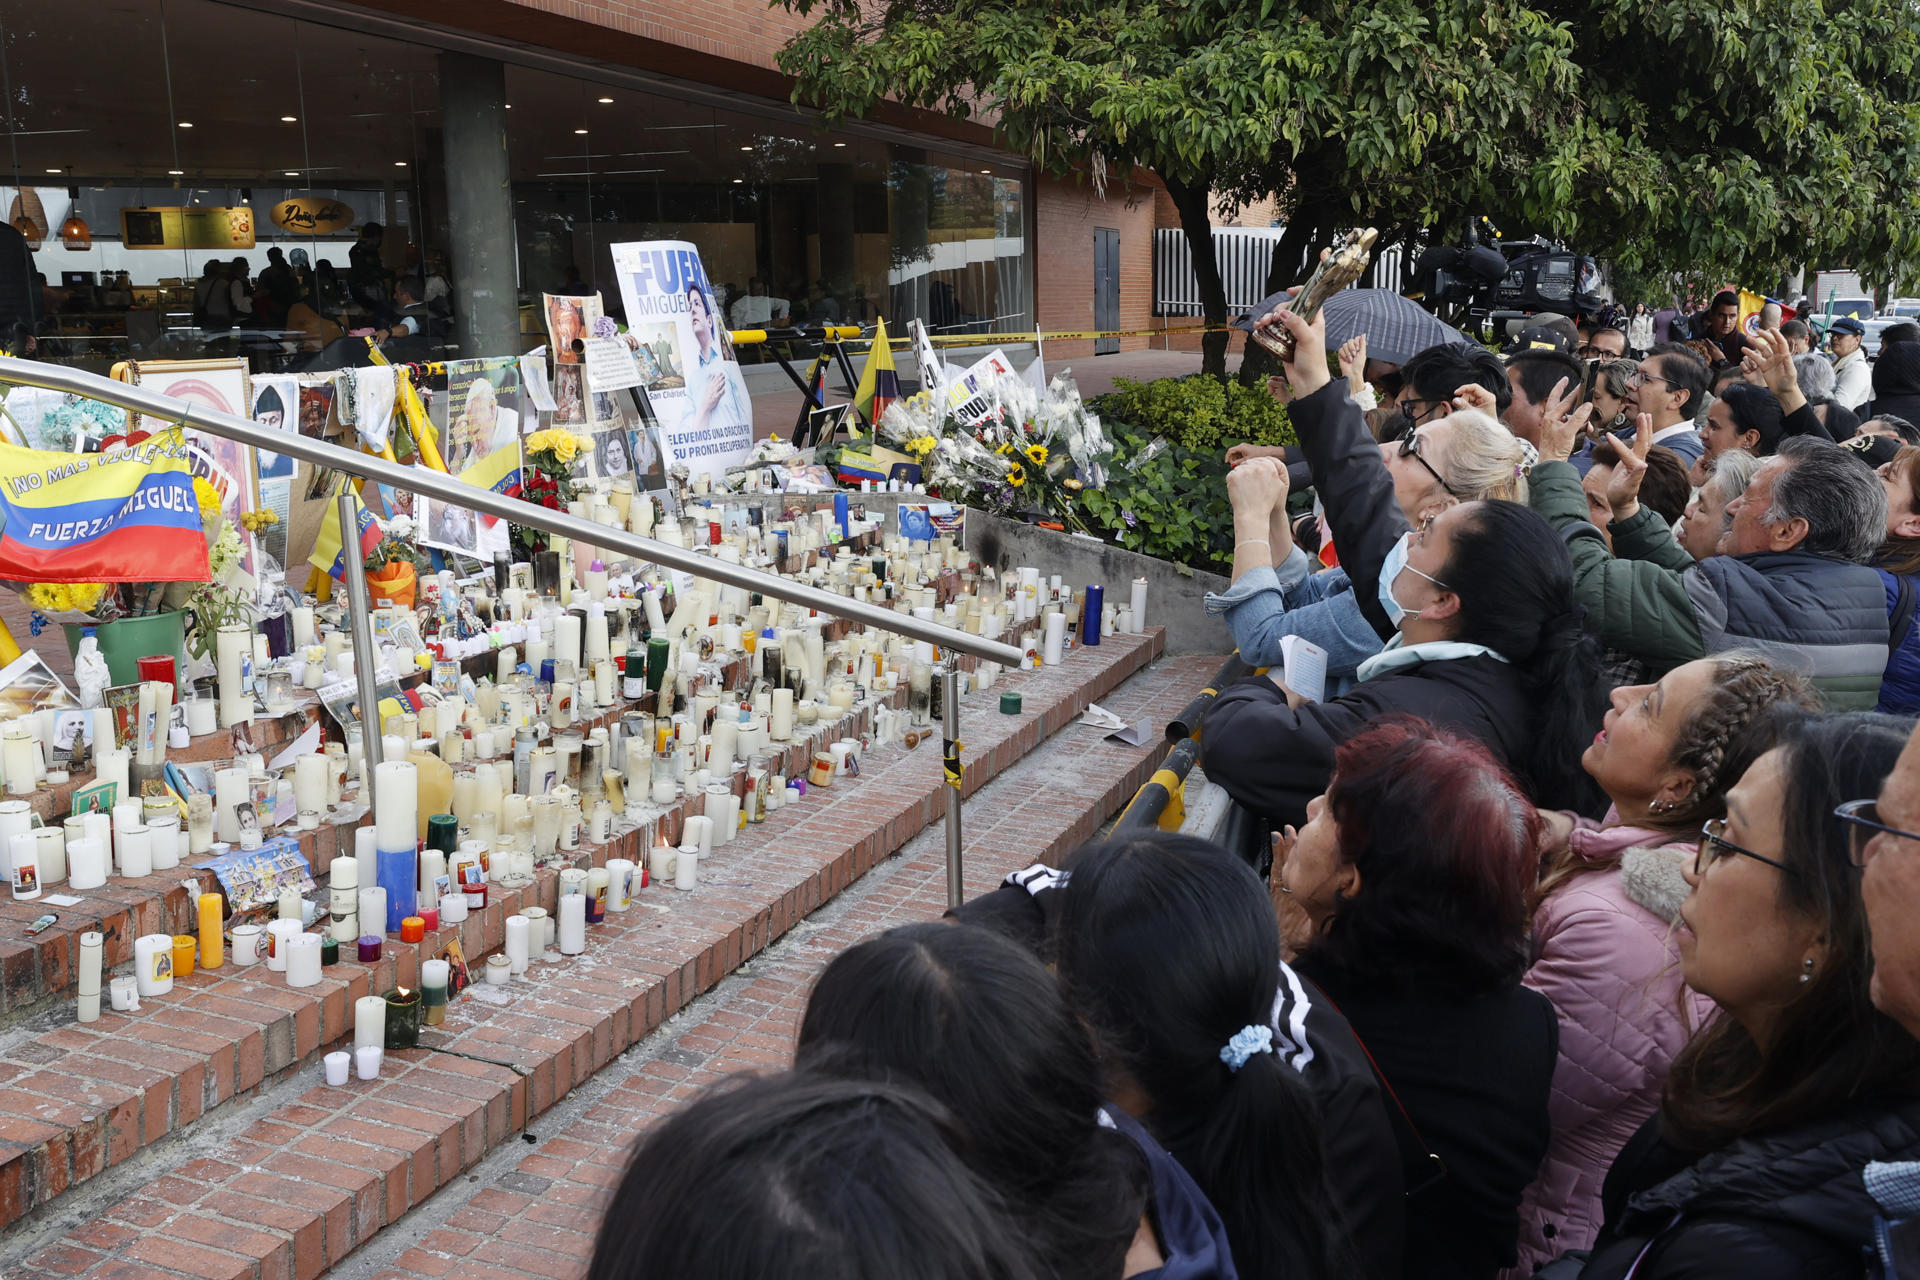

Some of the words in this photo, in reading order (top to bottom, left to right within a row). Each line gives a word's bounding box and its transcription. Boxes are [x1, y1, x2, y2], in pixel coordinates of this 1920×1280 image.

[668, 429, 711, 446] ELEVEMOS
[712, 427, 724, 439] UNA
[673, 448, 686, 460] SU
[689, 444, 719, 458] PRONTA
[4, 473, 42, 499] ¡NO
[47, 458, 90, 485] MAS
[28, 514, 114, 542] FUERZA
[118, 485, 194, 519] MIGUEL
